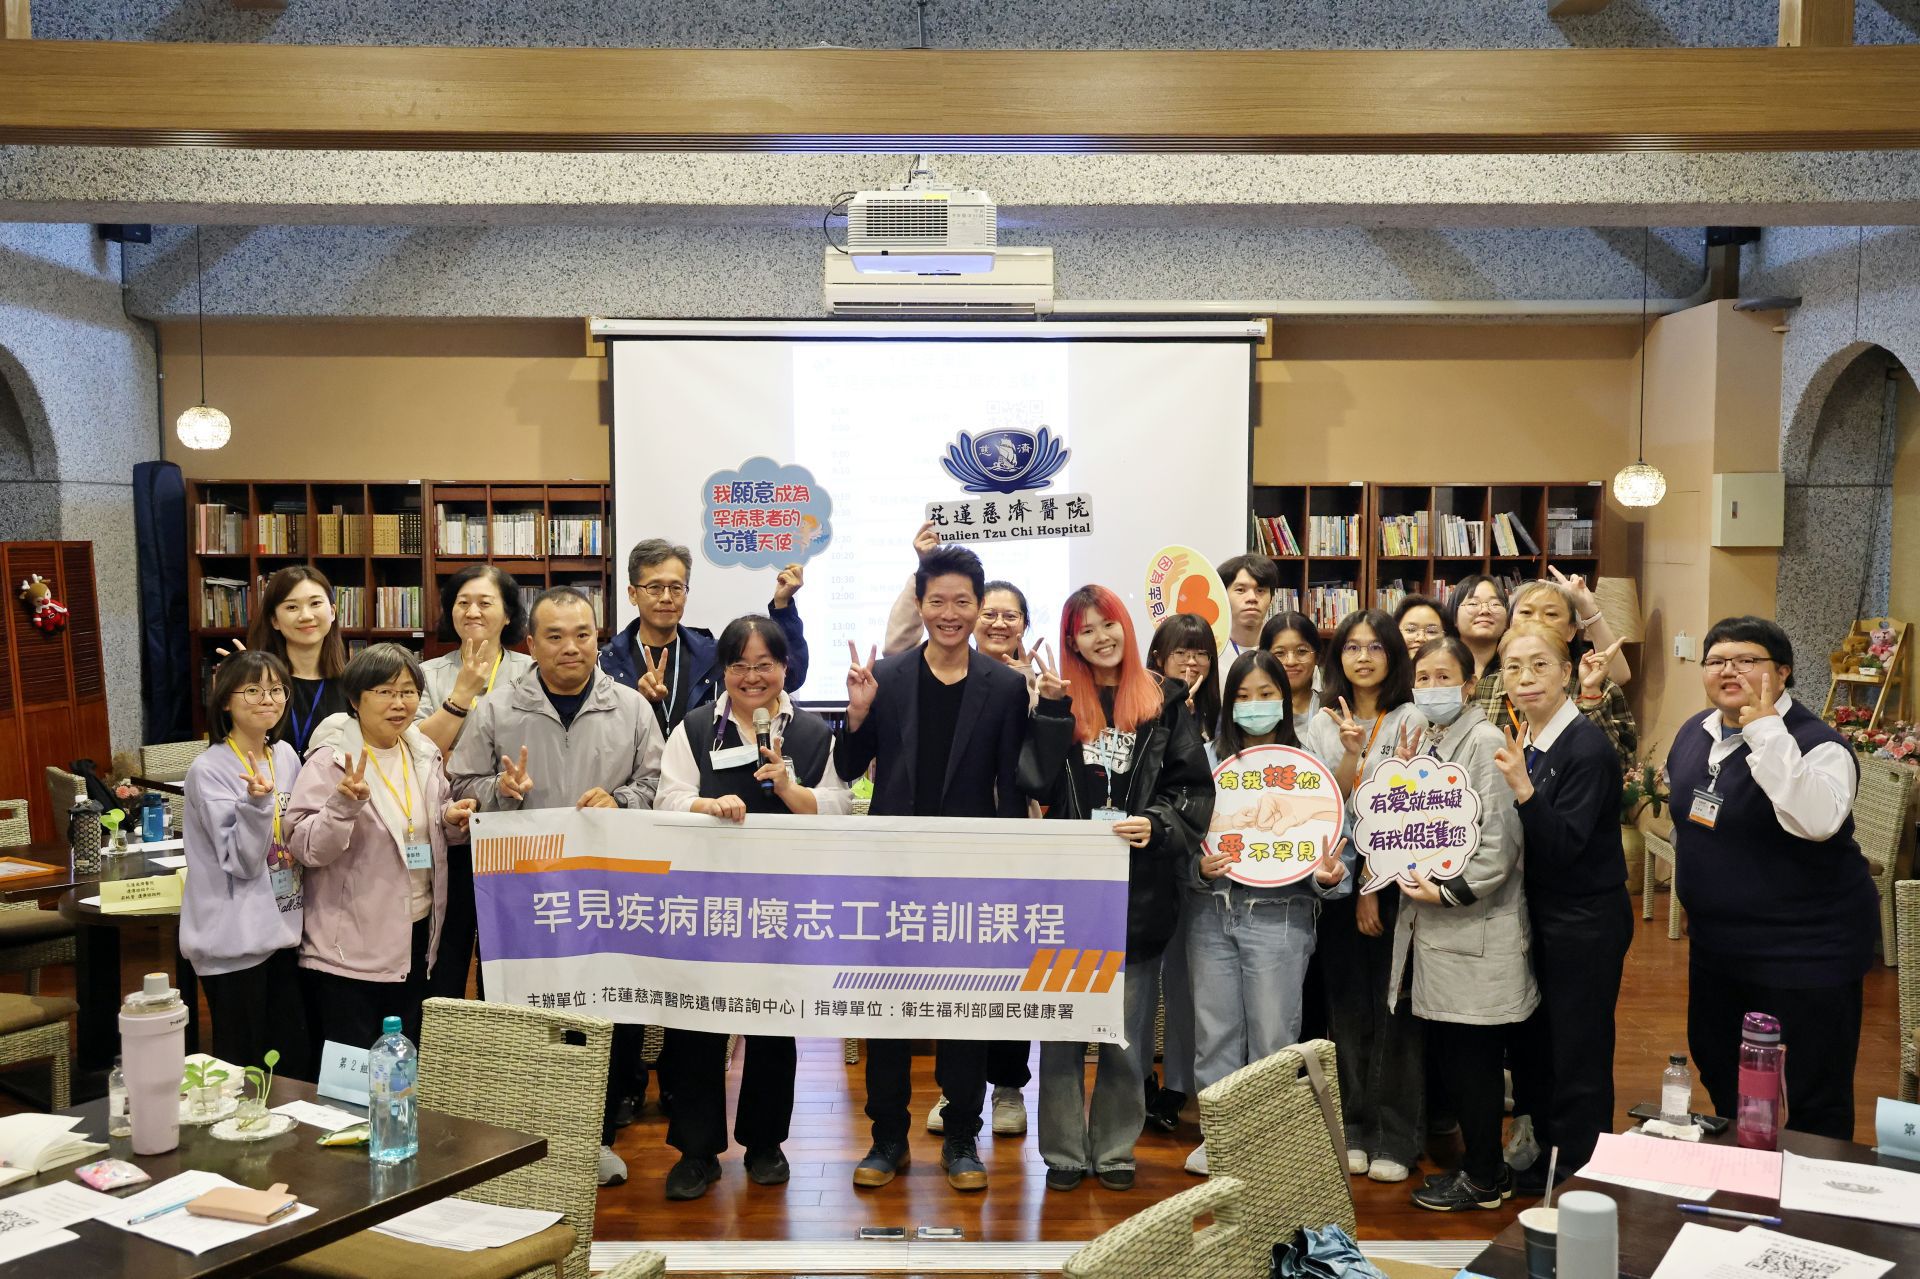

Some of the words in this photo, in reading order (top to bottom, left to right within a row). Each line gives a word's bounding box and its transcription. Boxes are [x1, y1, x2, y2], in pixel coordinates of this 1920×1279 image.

[713, 480, 810, 504] 我願意成為
[713, 508, 801, 528] 罕病患者的
[930, 496, 1090, 526] 花蓮慈濟醫院
[713, 529, 793, 552] 守護天使
[983, 529, 1007, 539] Tzu
[1011, 526, 1033, 537] Chi
[1037, 522, 1092, 537] Hospital
[1217, 764, 1321, 791] 有我挺你
[1369, 784, 1463, 814] 有愛就無礙
[1218, 833, 1317, 863] 愛不罕見
[1369, 820, 1467, 851] 有我照護您
[533, 889, 1066, 944] 罕見疾病關懷志工培訓課程
